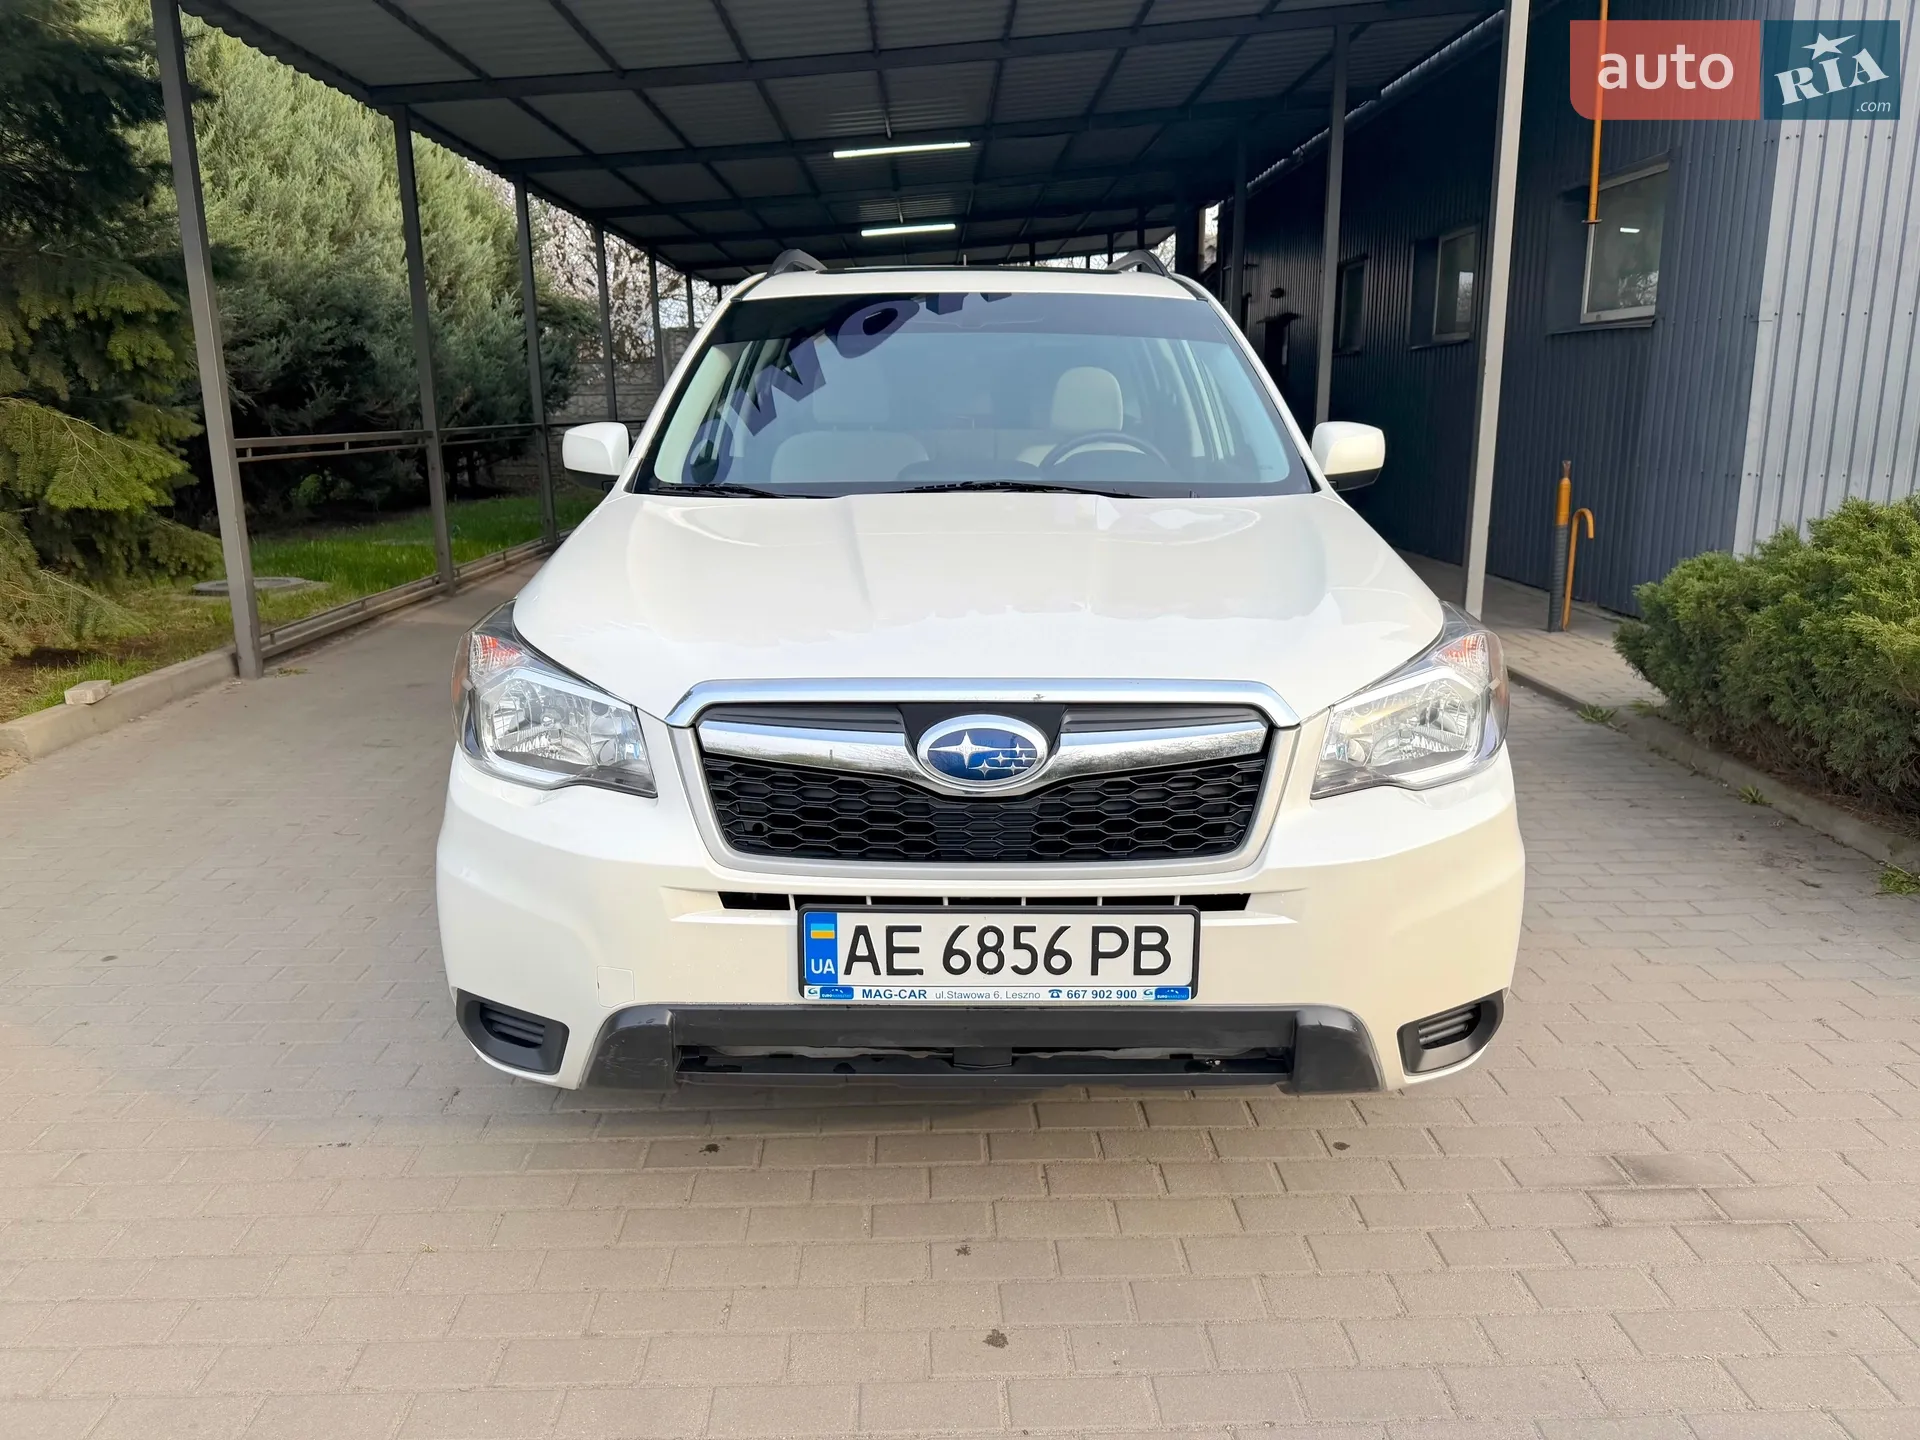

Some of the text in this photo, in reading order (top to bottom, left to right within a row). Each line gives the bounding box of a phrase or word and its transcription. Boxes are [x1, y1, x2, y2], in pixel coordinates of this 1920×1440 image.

[843, 924, 1173, 976] AE 6856 PB
[810, 958, 836, 975] UA
[861, 989, 928, 999] MAG-CAR
[1005, 990, 1041, 999] Leszno
[1066, 989, 1087, 999] 667
[1091, 989, 1113, 999] 902
[1116, 989, 1138, 999] 900
